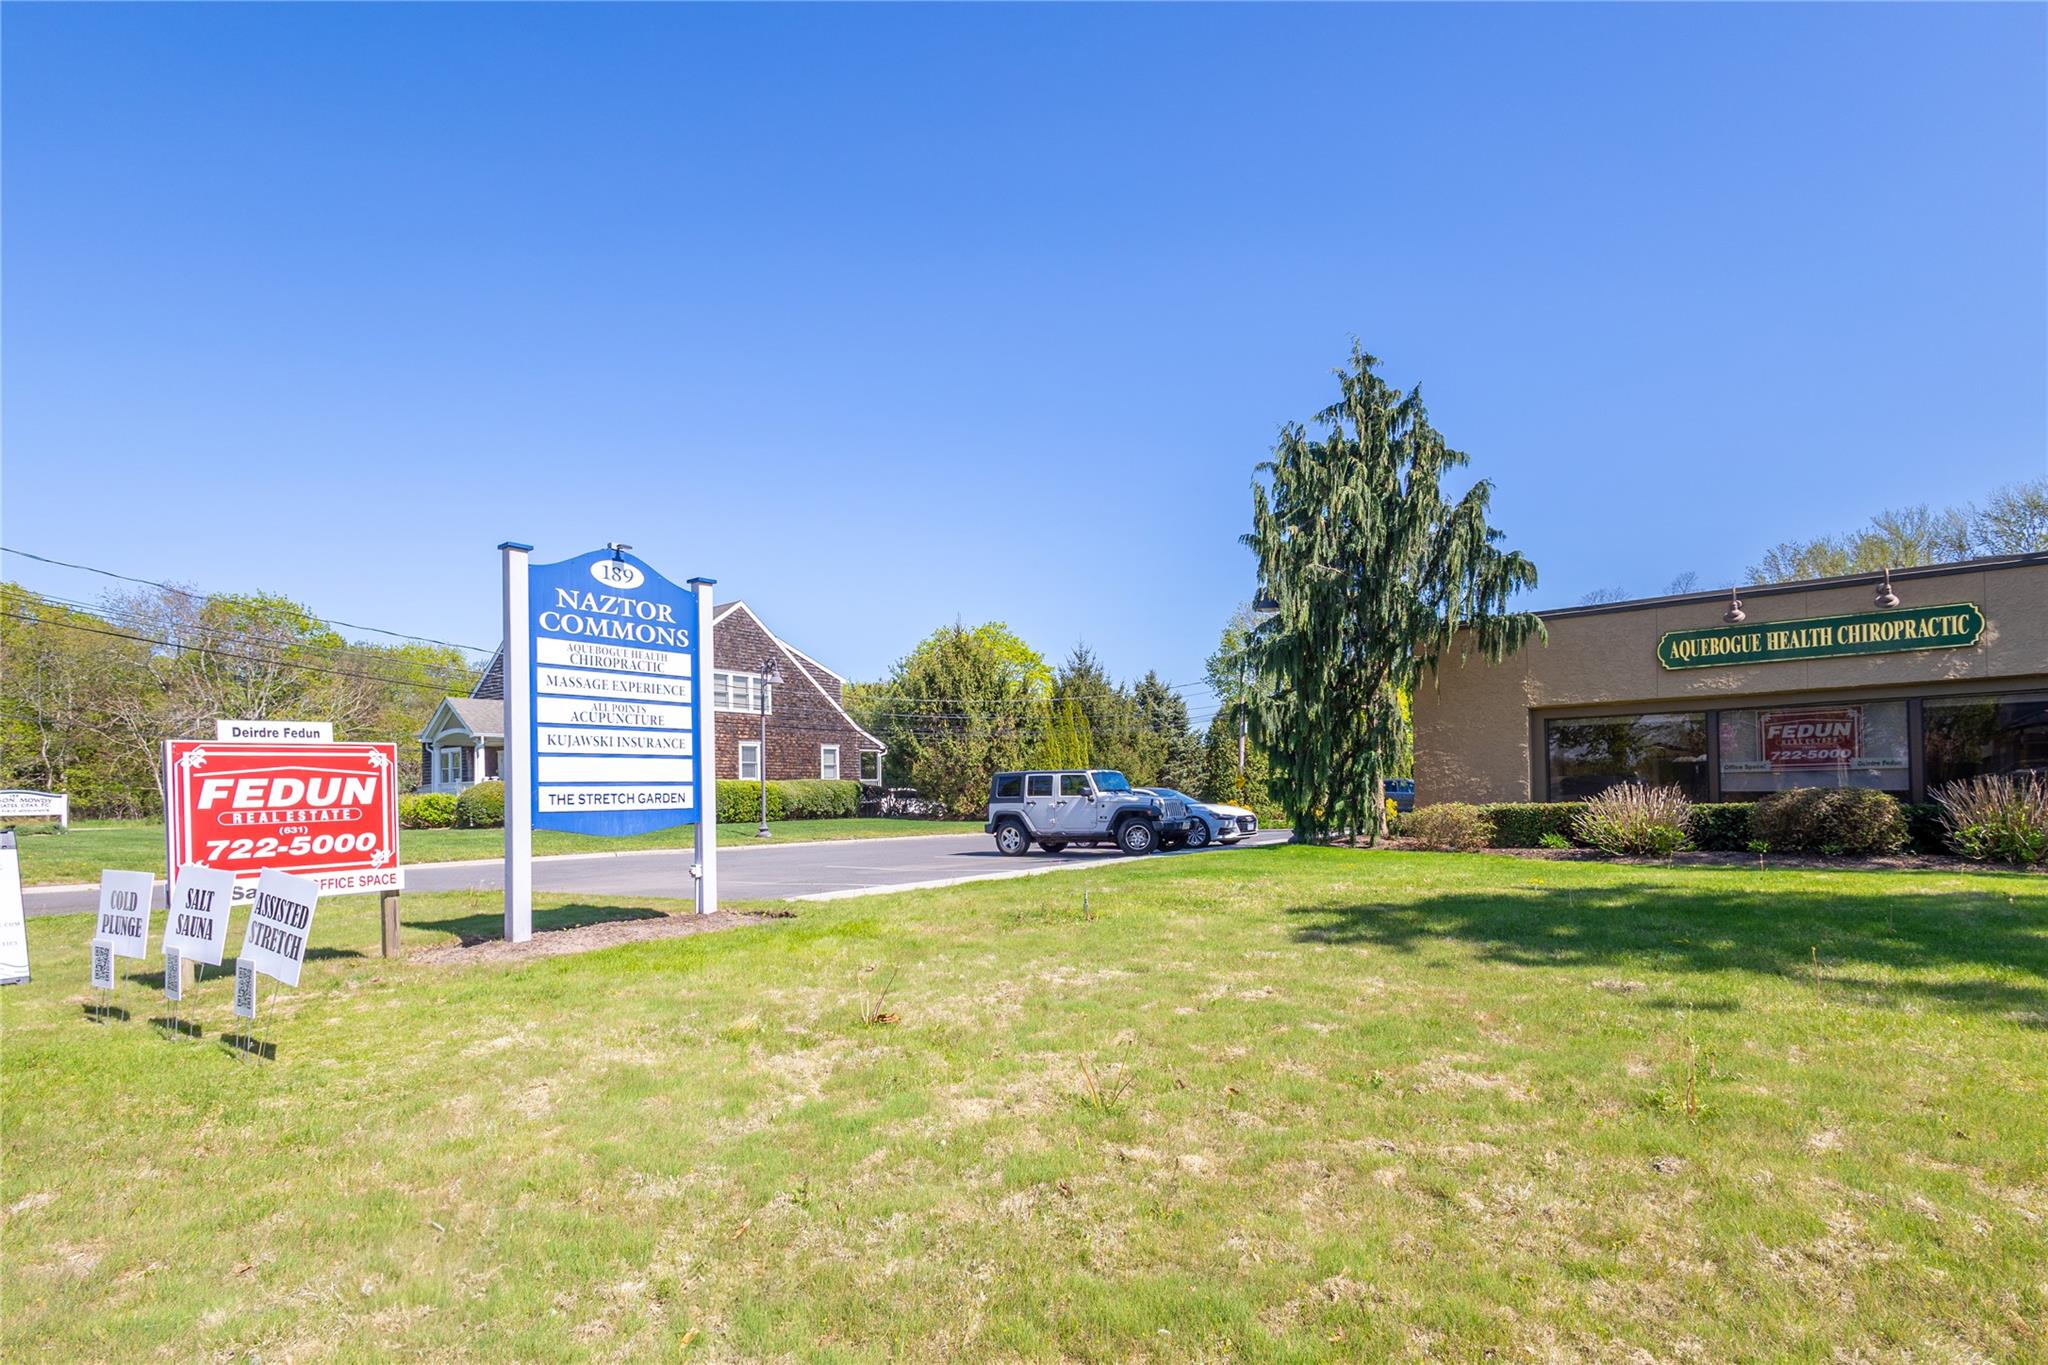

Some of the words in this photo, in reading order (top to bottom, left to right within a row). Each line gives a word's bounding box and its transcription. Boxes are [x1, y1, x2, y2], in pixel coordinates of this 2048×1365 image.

[602, 565, 634, 583] 189
[555, 587, 676, 624] NAZTOR
[539, 611, 689, 648] COMMONS
[1669, 633, 1762, 661] AQUEBOGUE
[1766, 627, 1833, 651] HEALTH
[1837, 614, 1970, 645] CHIROPRACTIC
[567, 643, 630, 658] AQUEBOGUE
[631, 650, 668, 662] HEALTH
[570, 653, 665, 673] CHIROPRACTIC
[546, 674, 609, 691] MASSAGE
[612, 680, 686, 697] EXPERIENCE
[592, 703, 608, 712] ALL
[612, 703, 647, 714] POINTS
[570, 711, 665, 726] ACUPUNCTURE
[232, 726, 279, 738] Deirdre
[284, 728, 320, 739] Fedun
[1767, 723, 1851, 739] FEDUN
[547, 734, 613, 748] KUJAWSKI
[617, 736, 686, 750] INSURANCE
[1771, 749, 1851, 760] 722-5000
[197, 777, 377, 810] FEDUN
[548, 794, 575, 805] THE
[578, 792, 635, 805] STRETCH
[638, 792, 686, 804] GARDEN
[233, 812, 280, 824] REAL
[282, 808, 350, 822] ESTATE
[279, 826, 308, 836] (631)
[206, 832, 376, 861] 722-5000
[314, 876, 354, 890] FFICE
[359, 873, 397, 887] SPACE
[110, 889, 137, 912] COLD
[185, 888, 215, 912] SALT
[232, 885, 257, 901] Sa
[254, 892, 310, 930] ASSISTED
[102, 914, 143, 938] PLUNGE
[176, 914, 213, 941] SAUNA
[249, 921, 303, 961] STRETCH
